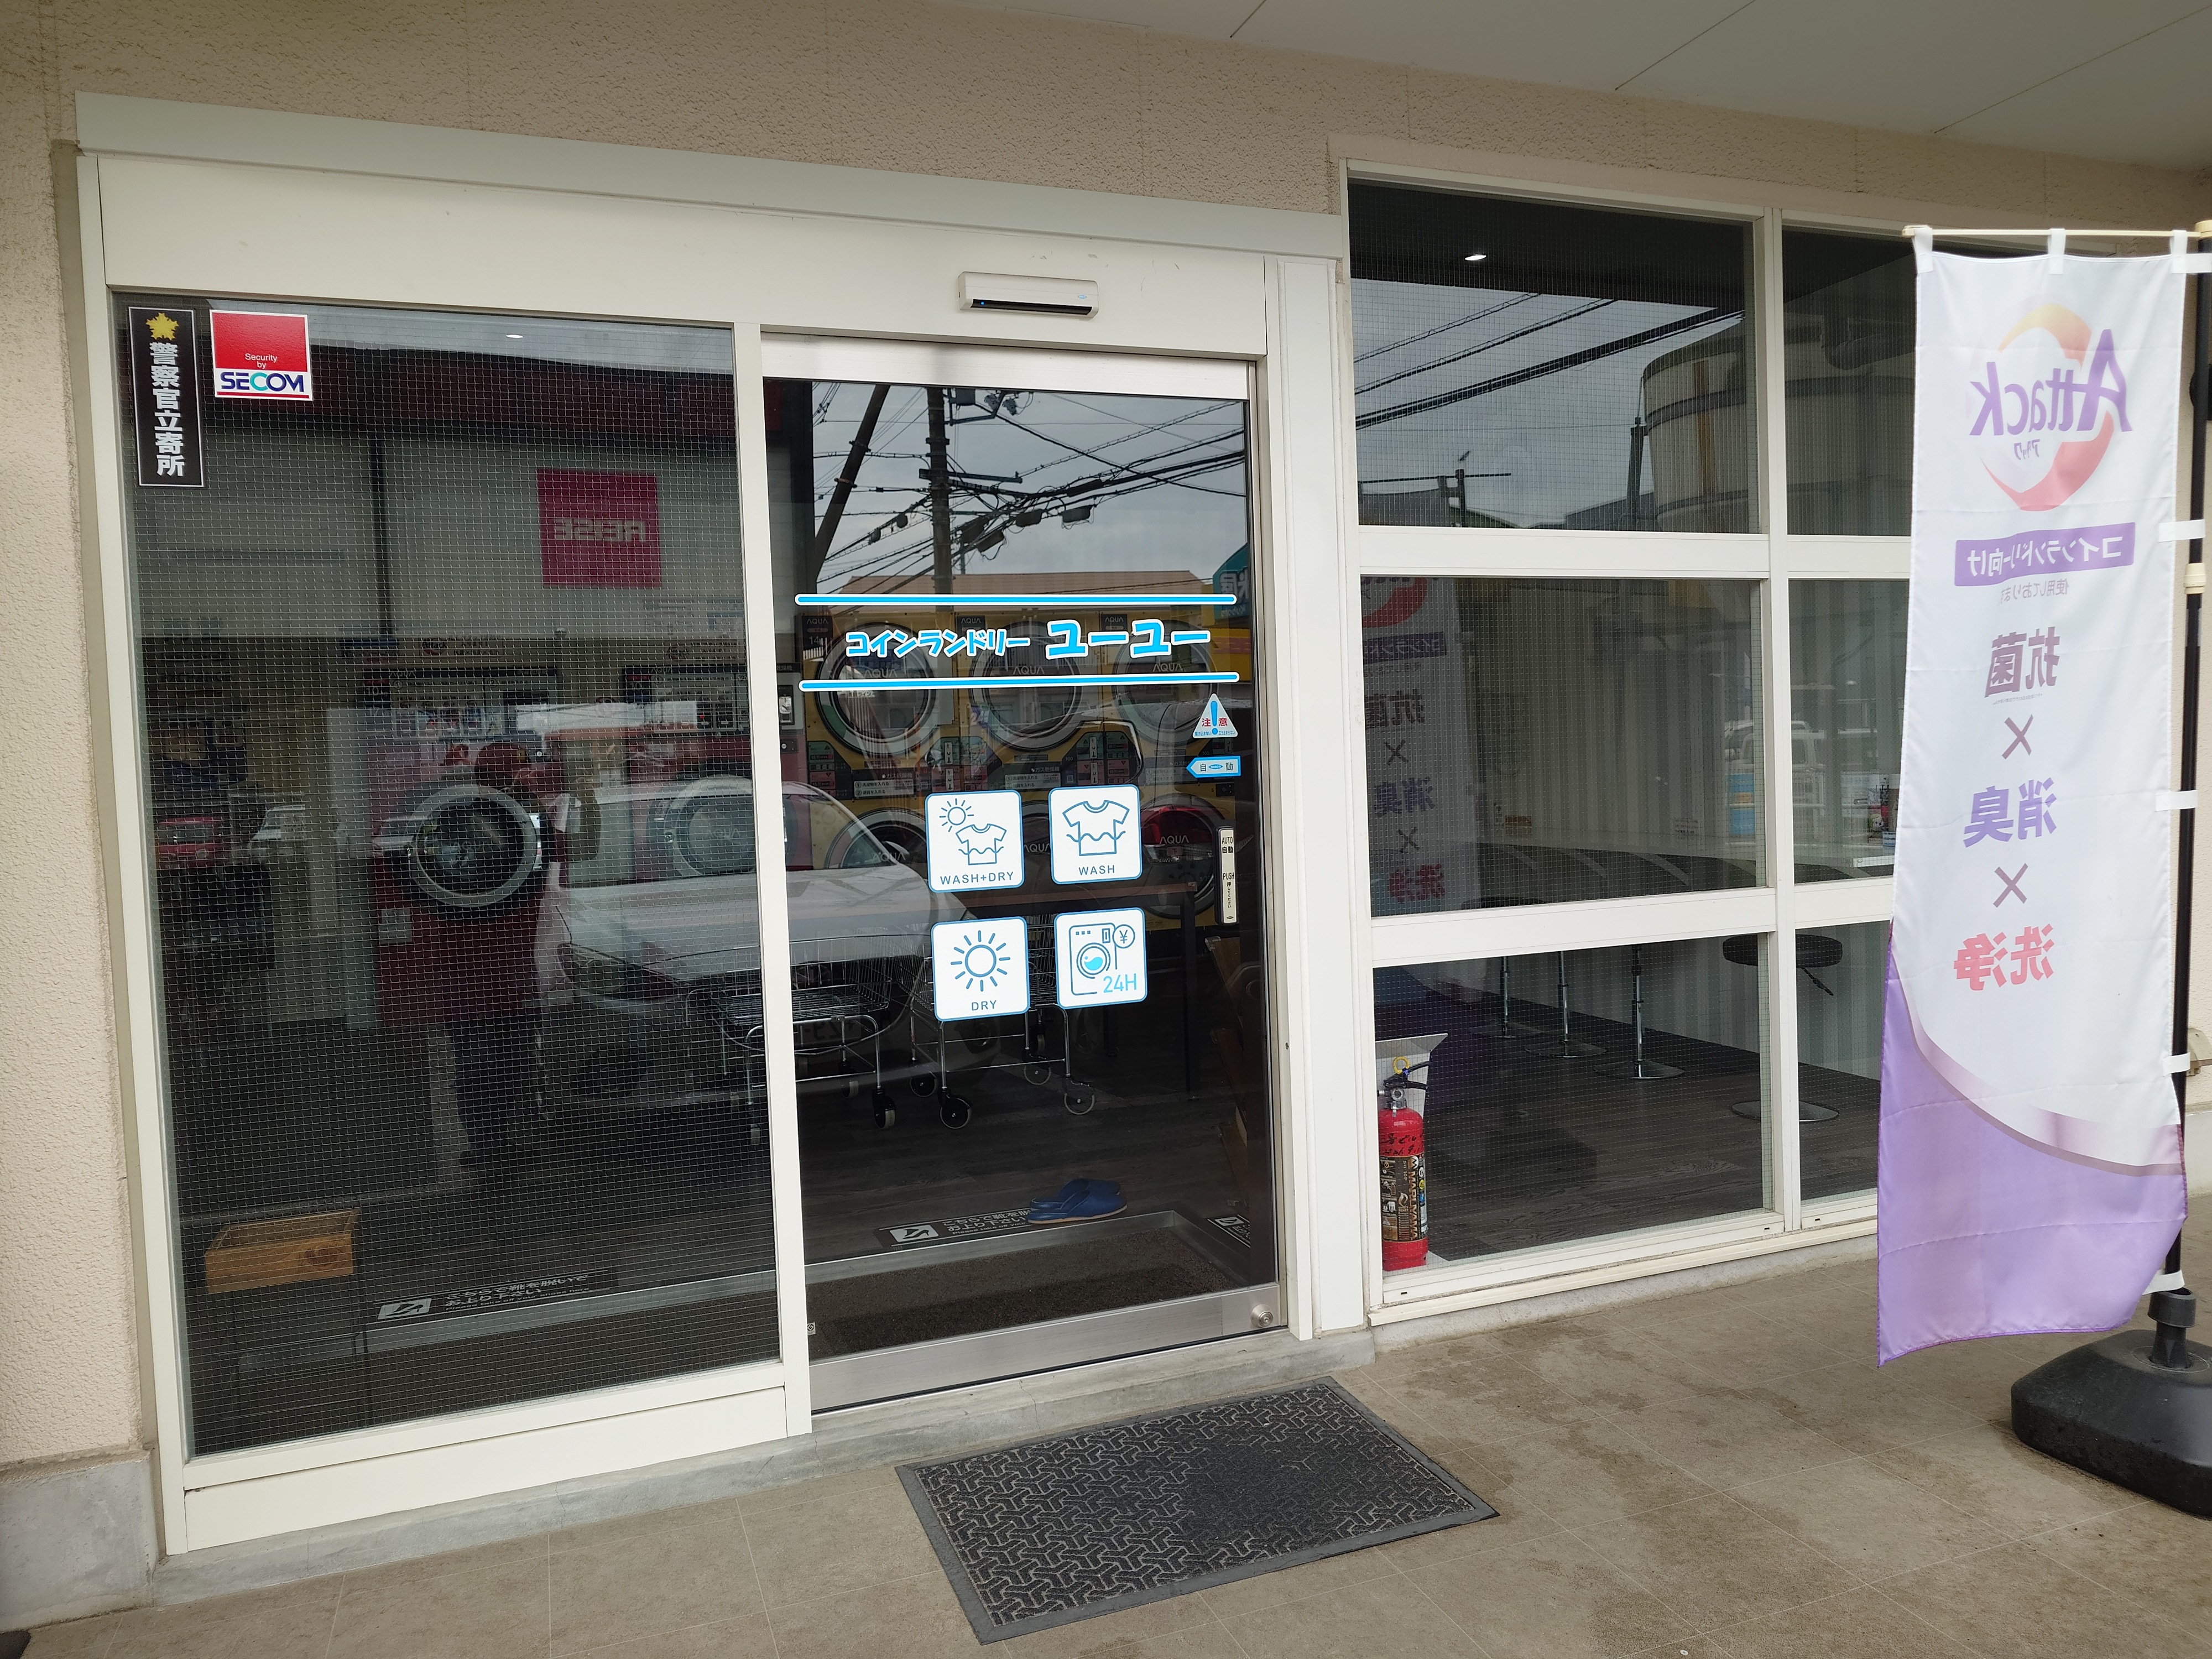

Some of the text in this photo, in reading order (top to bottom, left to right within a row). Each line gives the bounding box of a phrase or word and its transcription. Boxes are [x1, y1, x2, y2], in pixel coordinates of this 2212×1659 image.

[245, 353, 278, 363] Security
[257, 361, 267, 369] by
[221, 372, 304, 393] SECOM
[149, 342, 185, 476] 警察官立寄所
[846, 619, 1211, 660] コインランドリー ユーユー
[1012, 665, 1045, 675] AQUA
[1152, 662, 1183, 673] AQUA
[864, 669, 898, 678] AQUA
[1160, 834, 1190, 844] AQUA
[1222, 836, 1233, 844] AUTO
[1079, 864, 1115, 876] WASH
[941, 871, 1014, 885] WASH+DRY
[1103, 973, 1137, 994] 24H
[972, 1000, 997, 1011] DRY
